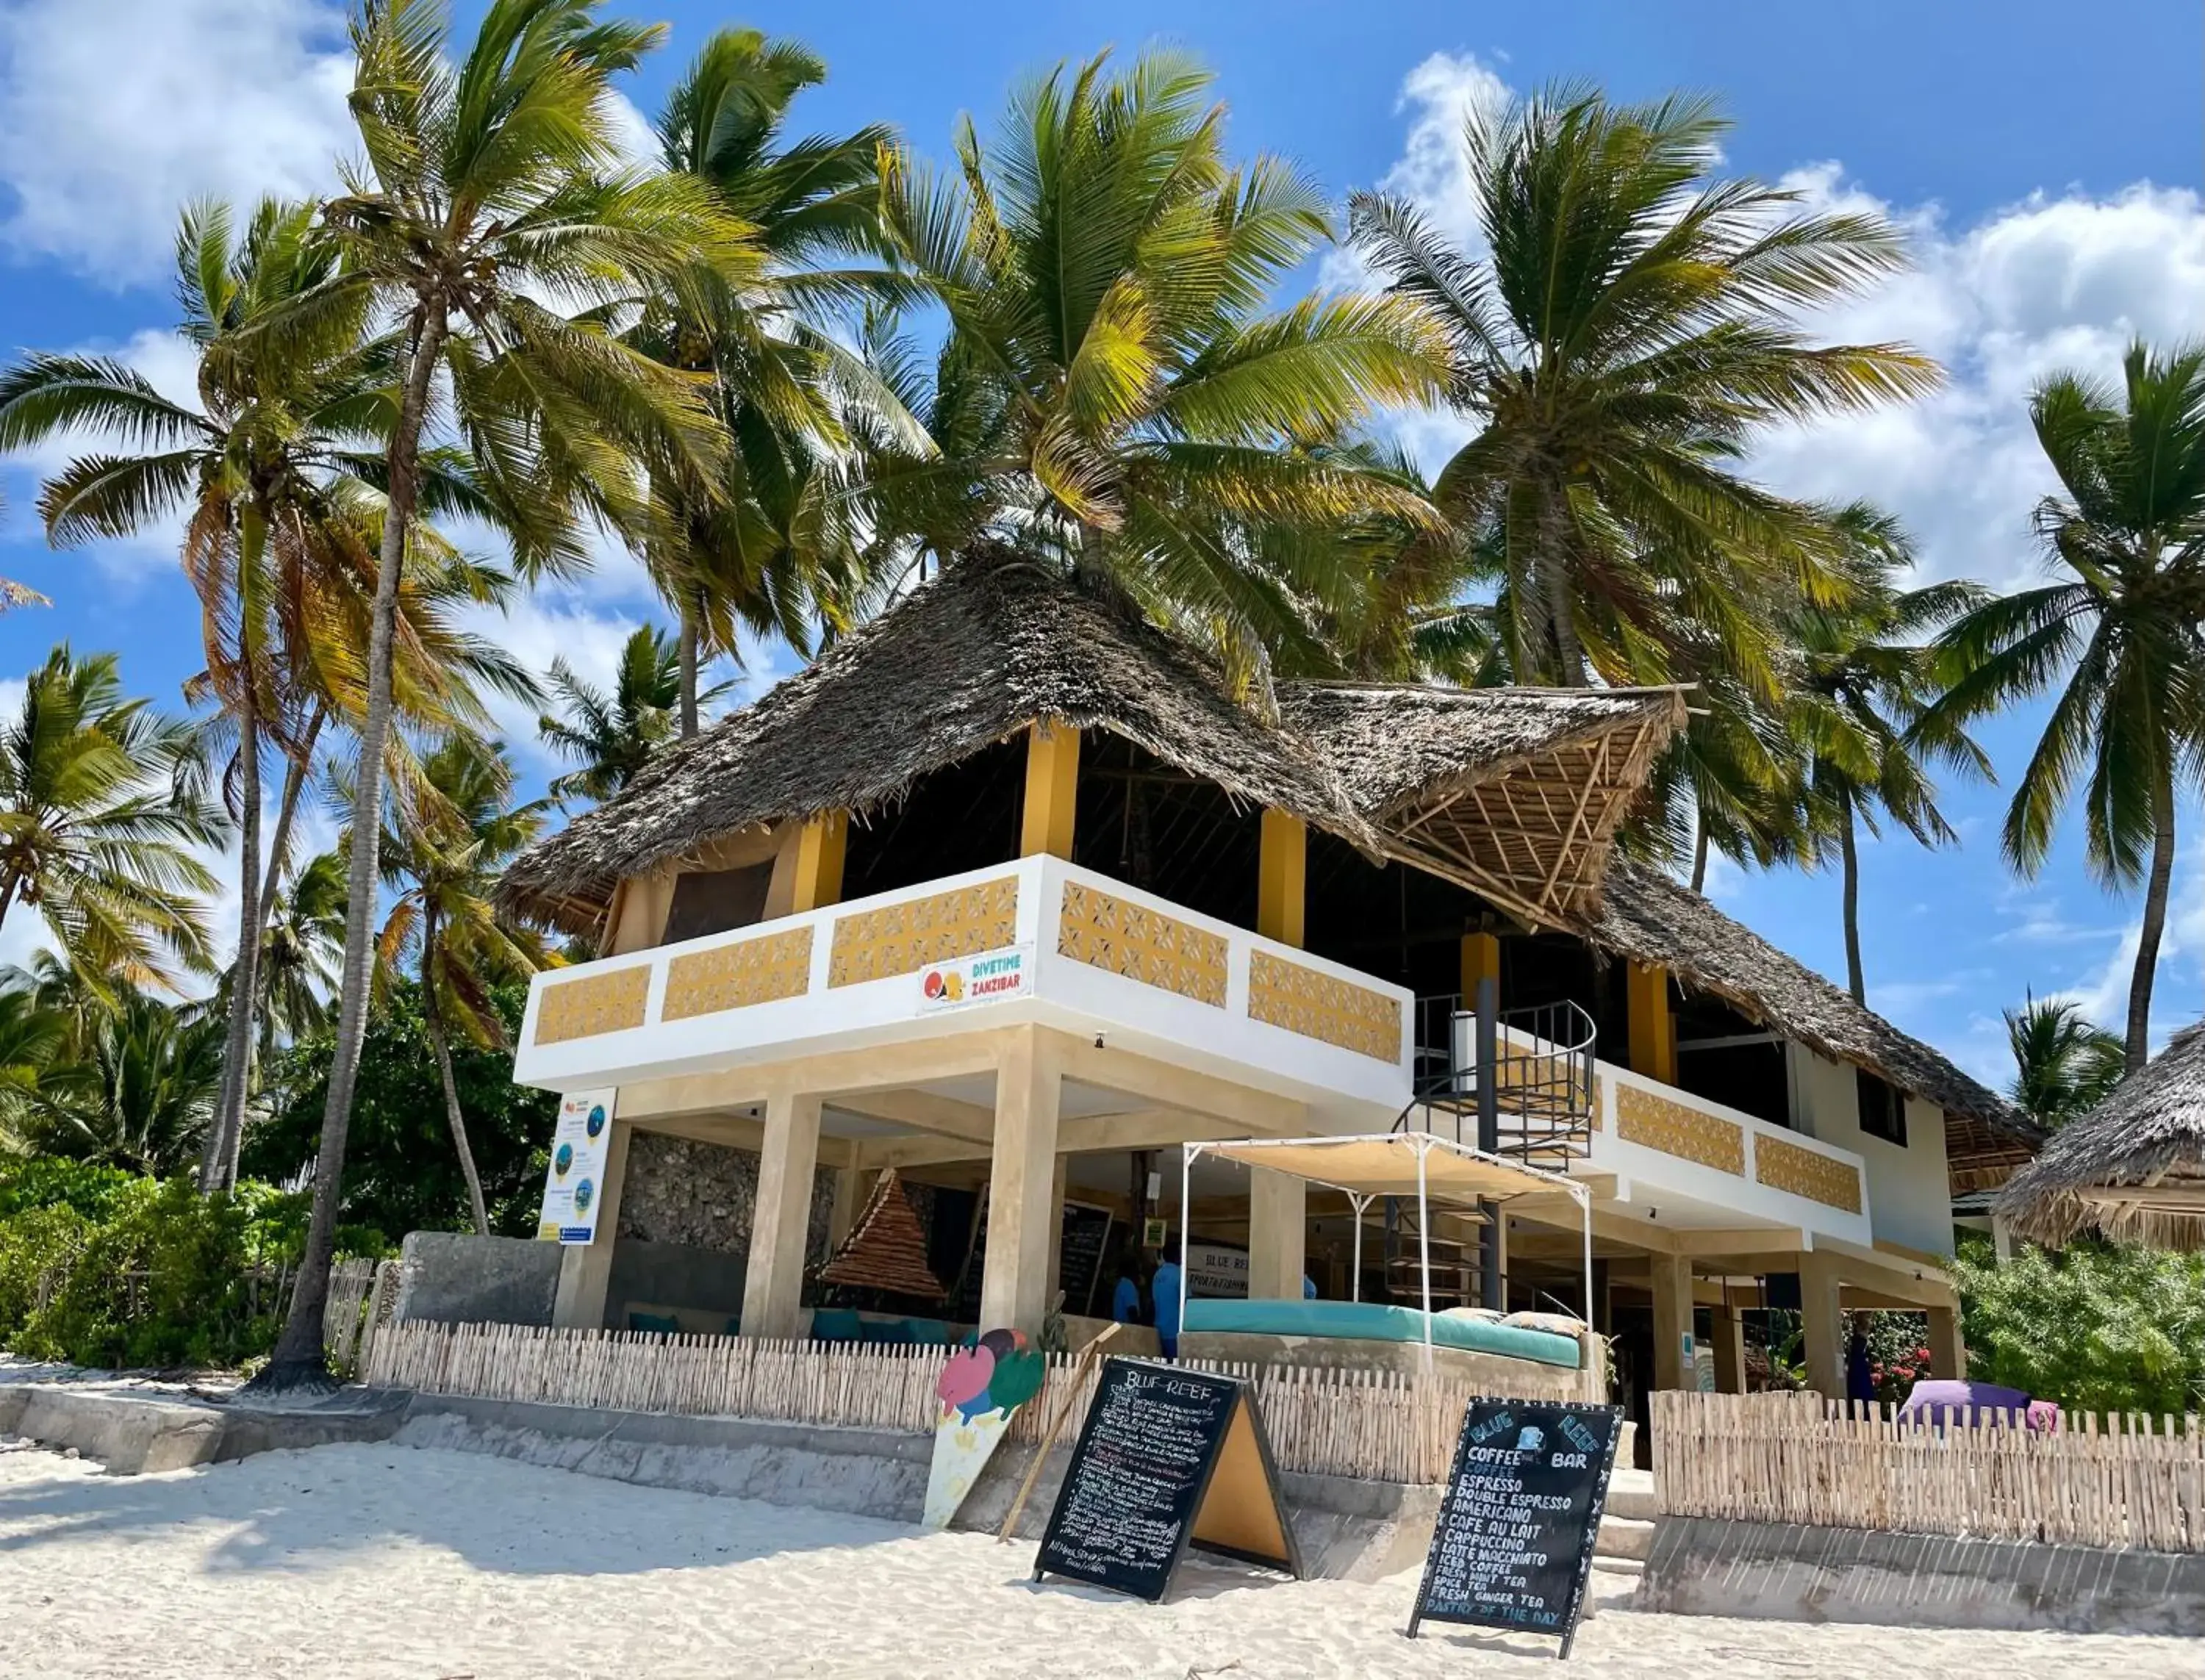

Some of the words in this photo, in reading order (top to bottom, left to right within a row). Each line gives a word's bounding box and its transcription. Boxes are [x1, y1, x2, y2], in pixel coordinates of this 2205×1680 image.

[972, 955, 1020, 977] DIVETIME
[972, 974, 1020, 997] ZANZIBAR
[1166, 1379, 1212, 1399] REEF
[1470, 1410, 1514, 1445] BLUE
[1557, 1414, 1600, 1454] REEF
[1465, 1461, 1515, 1477] COFFEE
[1468, 1446, 1522, 1466] COFFEE
[1551, 1452, 1588, 1469] BAR
[1459, 1473, 1522, 1493] ESPRESSO
[1456, 1486, 1507, 1506] DOUBLE
[1510, 1493, 1572, 1510] ESPRESSO
[1452, 1499, 1532, 1523] AMERICANO
[1449, 1513, 1482, 1533] CAFE
[1488, 1521, 1508, 1536] AU
[1511, 1523, 1542, 1540] LAIT
[1444, 1528, 1525, 1551] CAPPUCCINO
[1438, 1554, 1465, 1570] ICED
[1470, 1559, 1512, 1574] COFFEE
[1441, 1543, 1475, 1560] LATTE
[1477, 1548, 1547, 1566] MACCHIATO
[1435, 1565, 1467, 1580] FRESH
[1504, 1576, 1527, 1588] TEA
[1469, 1579, 1487, 1591] TEA
[1425, 1598, 1471, 1615] PASTRY
[1430, 1586, 1469, 1601] FRESH
[1475, 1592, 1514, 1604] GINGER
[1521, 1593, 1544, 1608] TEA
